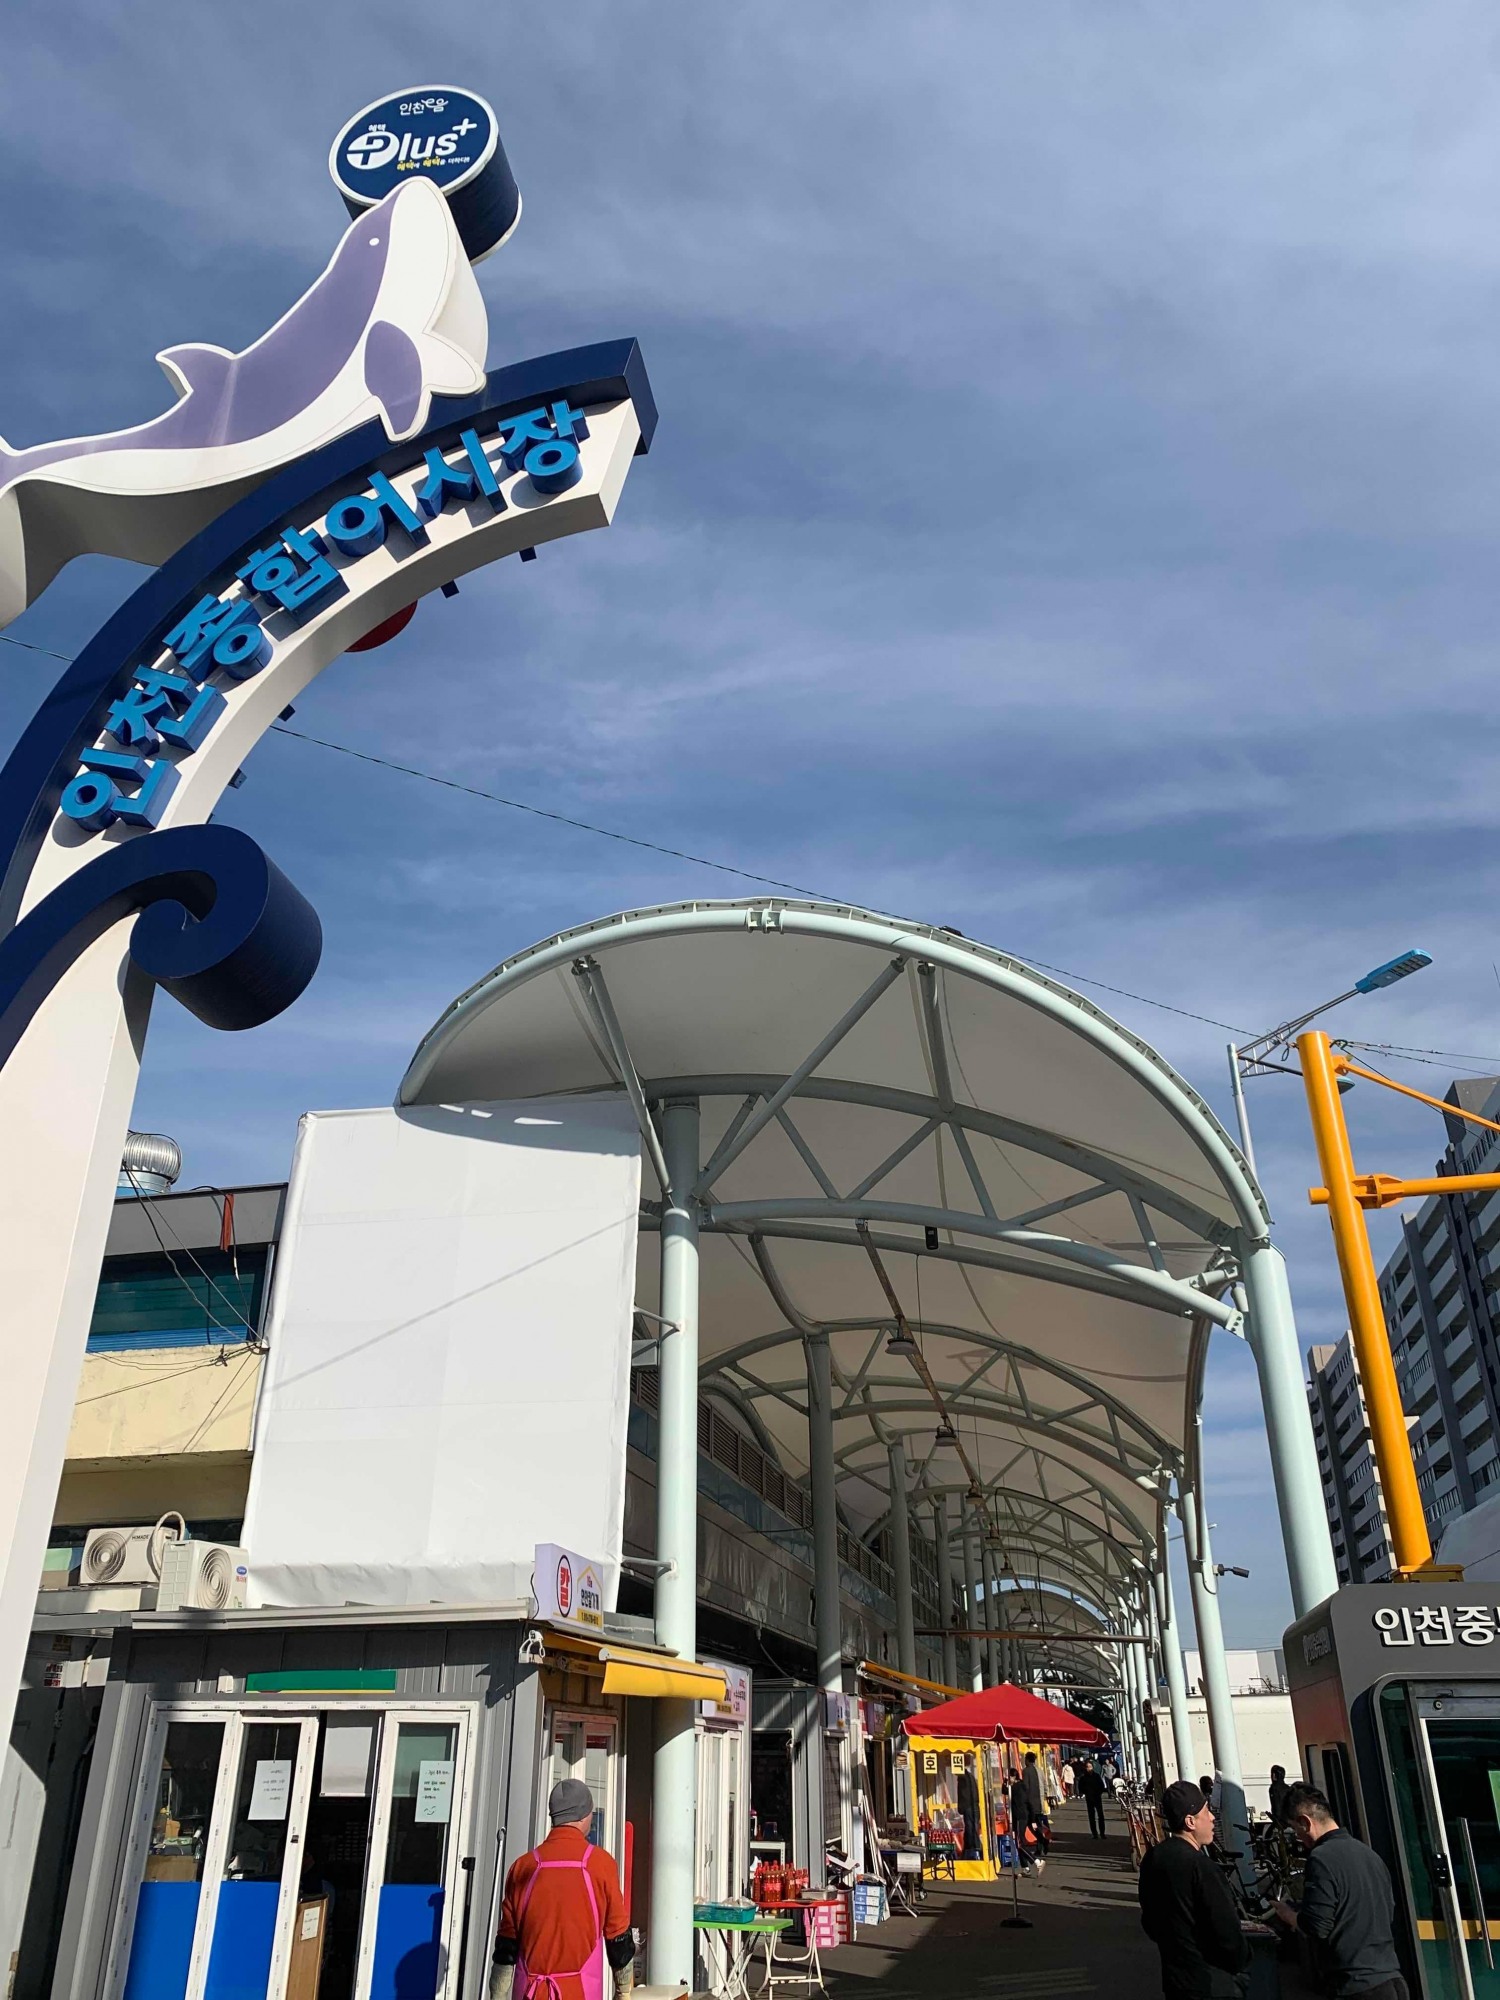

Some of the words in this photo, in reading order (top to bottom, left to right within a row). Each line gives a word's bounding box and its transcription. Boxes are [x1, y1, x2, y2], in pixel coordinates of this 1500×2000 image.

[60, 400, 591, 834] 인천종합어시장
[560, 1567, 570, 1607] 칼
[1373, 1606, 1500, 1647] 인천중
[925, 1755, 936, 1770] 호
